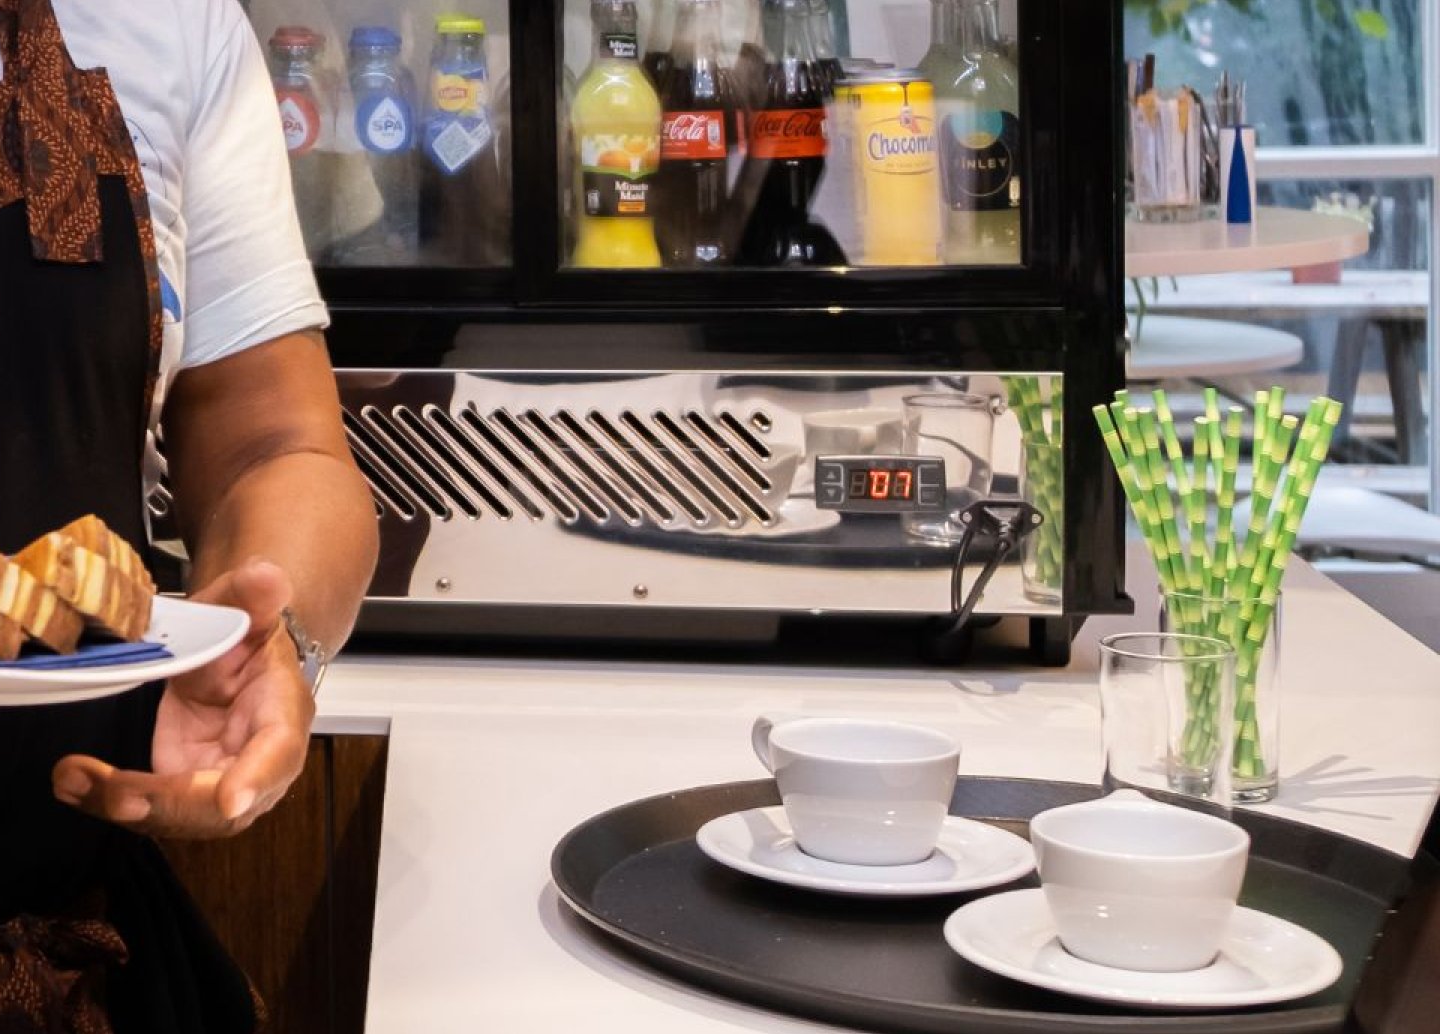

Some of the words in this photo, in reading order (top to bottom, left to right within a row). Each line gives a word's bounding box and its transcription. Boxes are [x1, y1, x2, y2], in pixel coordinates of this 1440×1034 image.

[283, 119, 304, 132] PA
[371, 119, 402, 131] SPA
[955, 157, 1007, 170] INLEY
